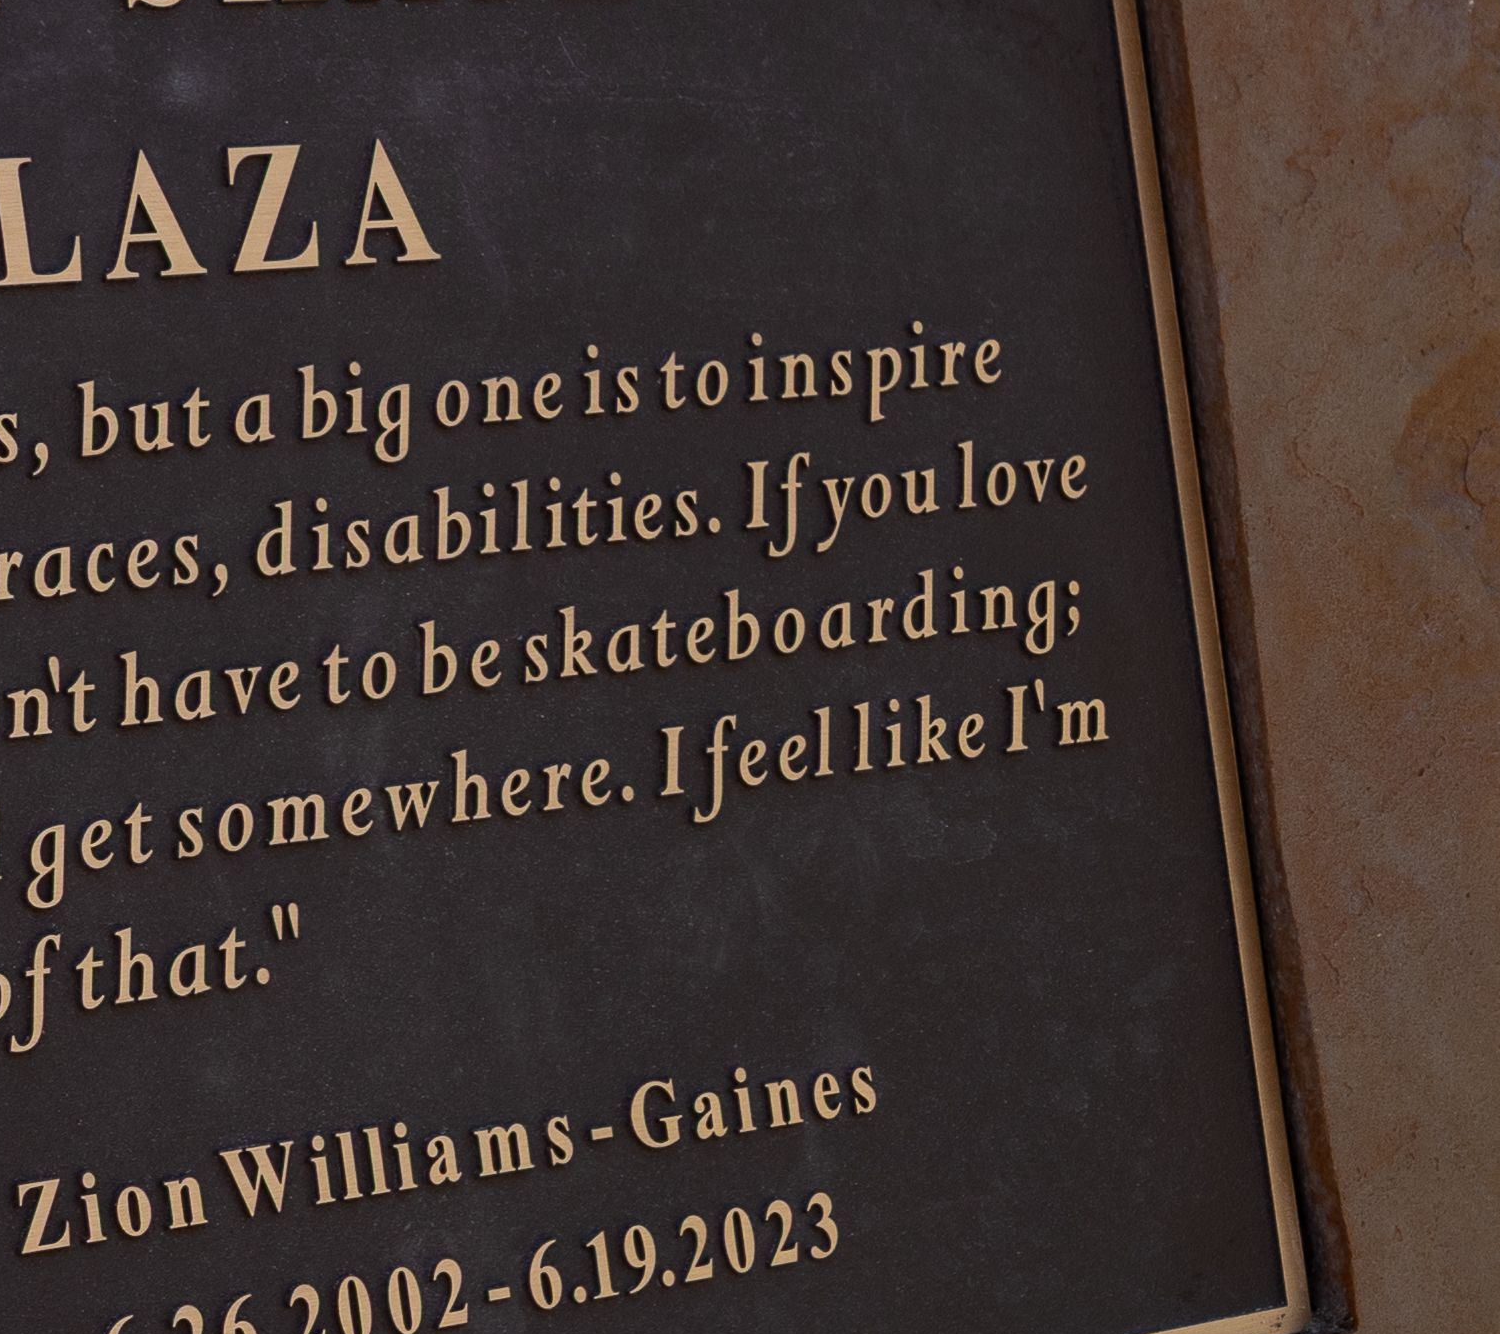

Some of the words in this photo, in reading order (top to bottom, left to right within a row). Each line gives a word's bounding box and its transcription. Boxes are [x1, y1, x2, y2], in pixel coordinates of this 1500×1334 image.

[75, 378, 214, 459] but
[232, 391, 278, 446] a
[296, 359, 412, 465] big
[434, 370, 566, 429] one
[581, 342, 642, 417] is
[658, 349, 731, 411] to
[746, 318, 1004, 424] inspire
[254, 469, 723, 579] disabilities.
[744, 450, 813, 560] If
[814, 466, 942, 555] you
[955, 438, 1090, 511] love
[118, 648, 303, 728] have
[320, 641, 399, 707] to
[417, 617, 504, 697] be
[523, 563, 1082, 685] skateboarding;
[24, 800, 156, 911] get
[176, 747, 637, 861] somewhere.
[658, 723, 687, 798] I
[691, 704, 836, 825] feel
[851, 692, 988, 774] like
[1004, 676, 1112, 754] I'm
[73, 900, 301, 1012] that."
[15, 1169, 211, 1257] Zion
